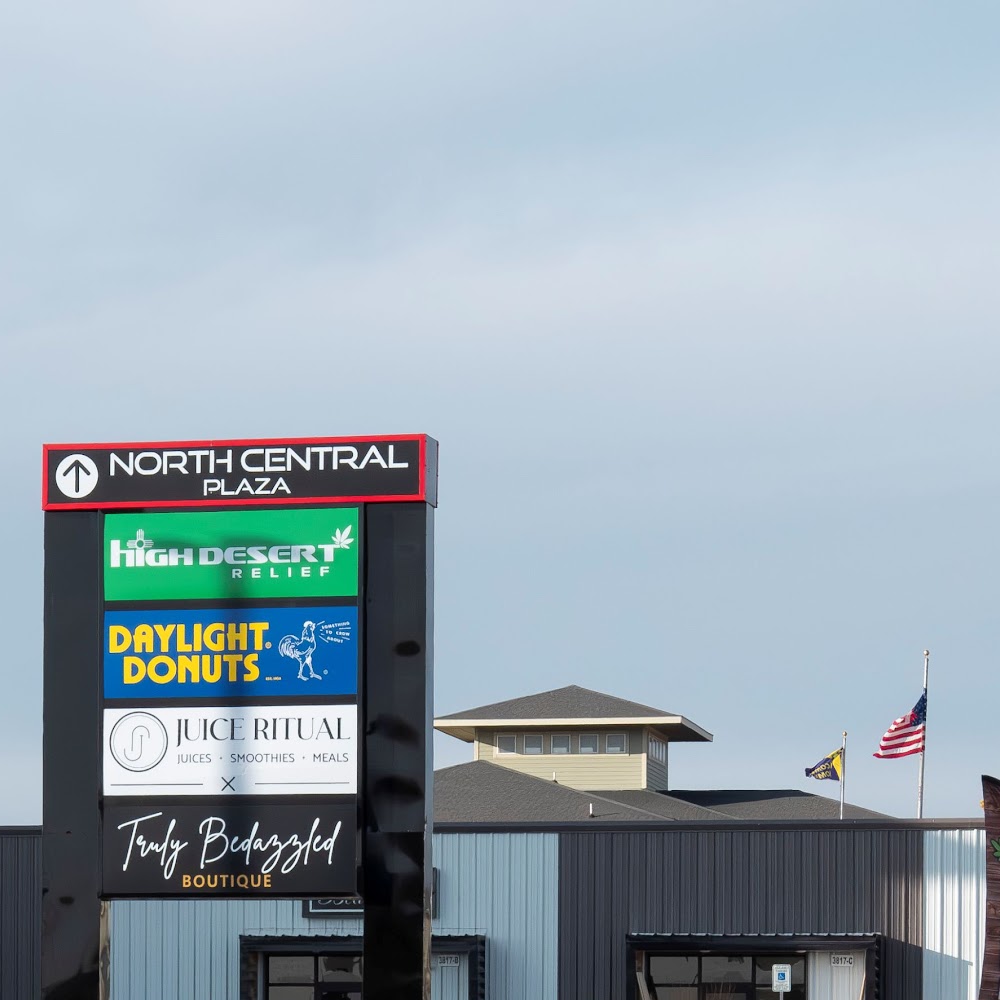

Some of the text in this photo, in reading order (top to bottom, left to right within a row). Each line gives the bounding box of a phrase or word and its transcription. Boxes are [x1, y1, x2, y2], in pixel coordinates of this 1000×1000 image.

[109, 444, 409, 476] NORTH CENTRAL
[203, 476, 291, 497] PLAZA
[198, 543, 340, 566] DESERT
[231, 565, 330, 579] RELIEF
[108, 622, 270, 654] DAYLIGHT
[123, 653, 260, 685] DONUTS
[176, 716, 351, 748] JUICE RITUAL
[177, 752, 349, 765] JUICES SMOOTHIES MEALS
[117, 812, 342, 880] Truly Bedazzled
[182, 874, 272, 888] BOUTIQUE
[832, 956, 853, 965] 3817-C
